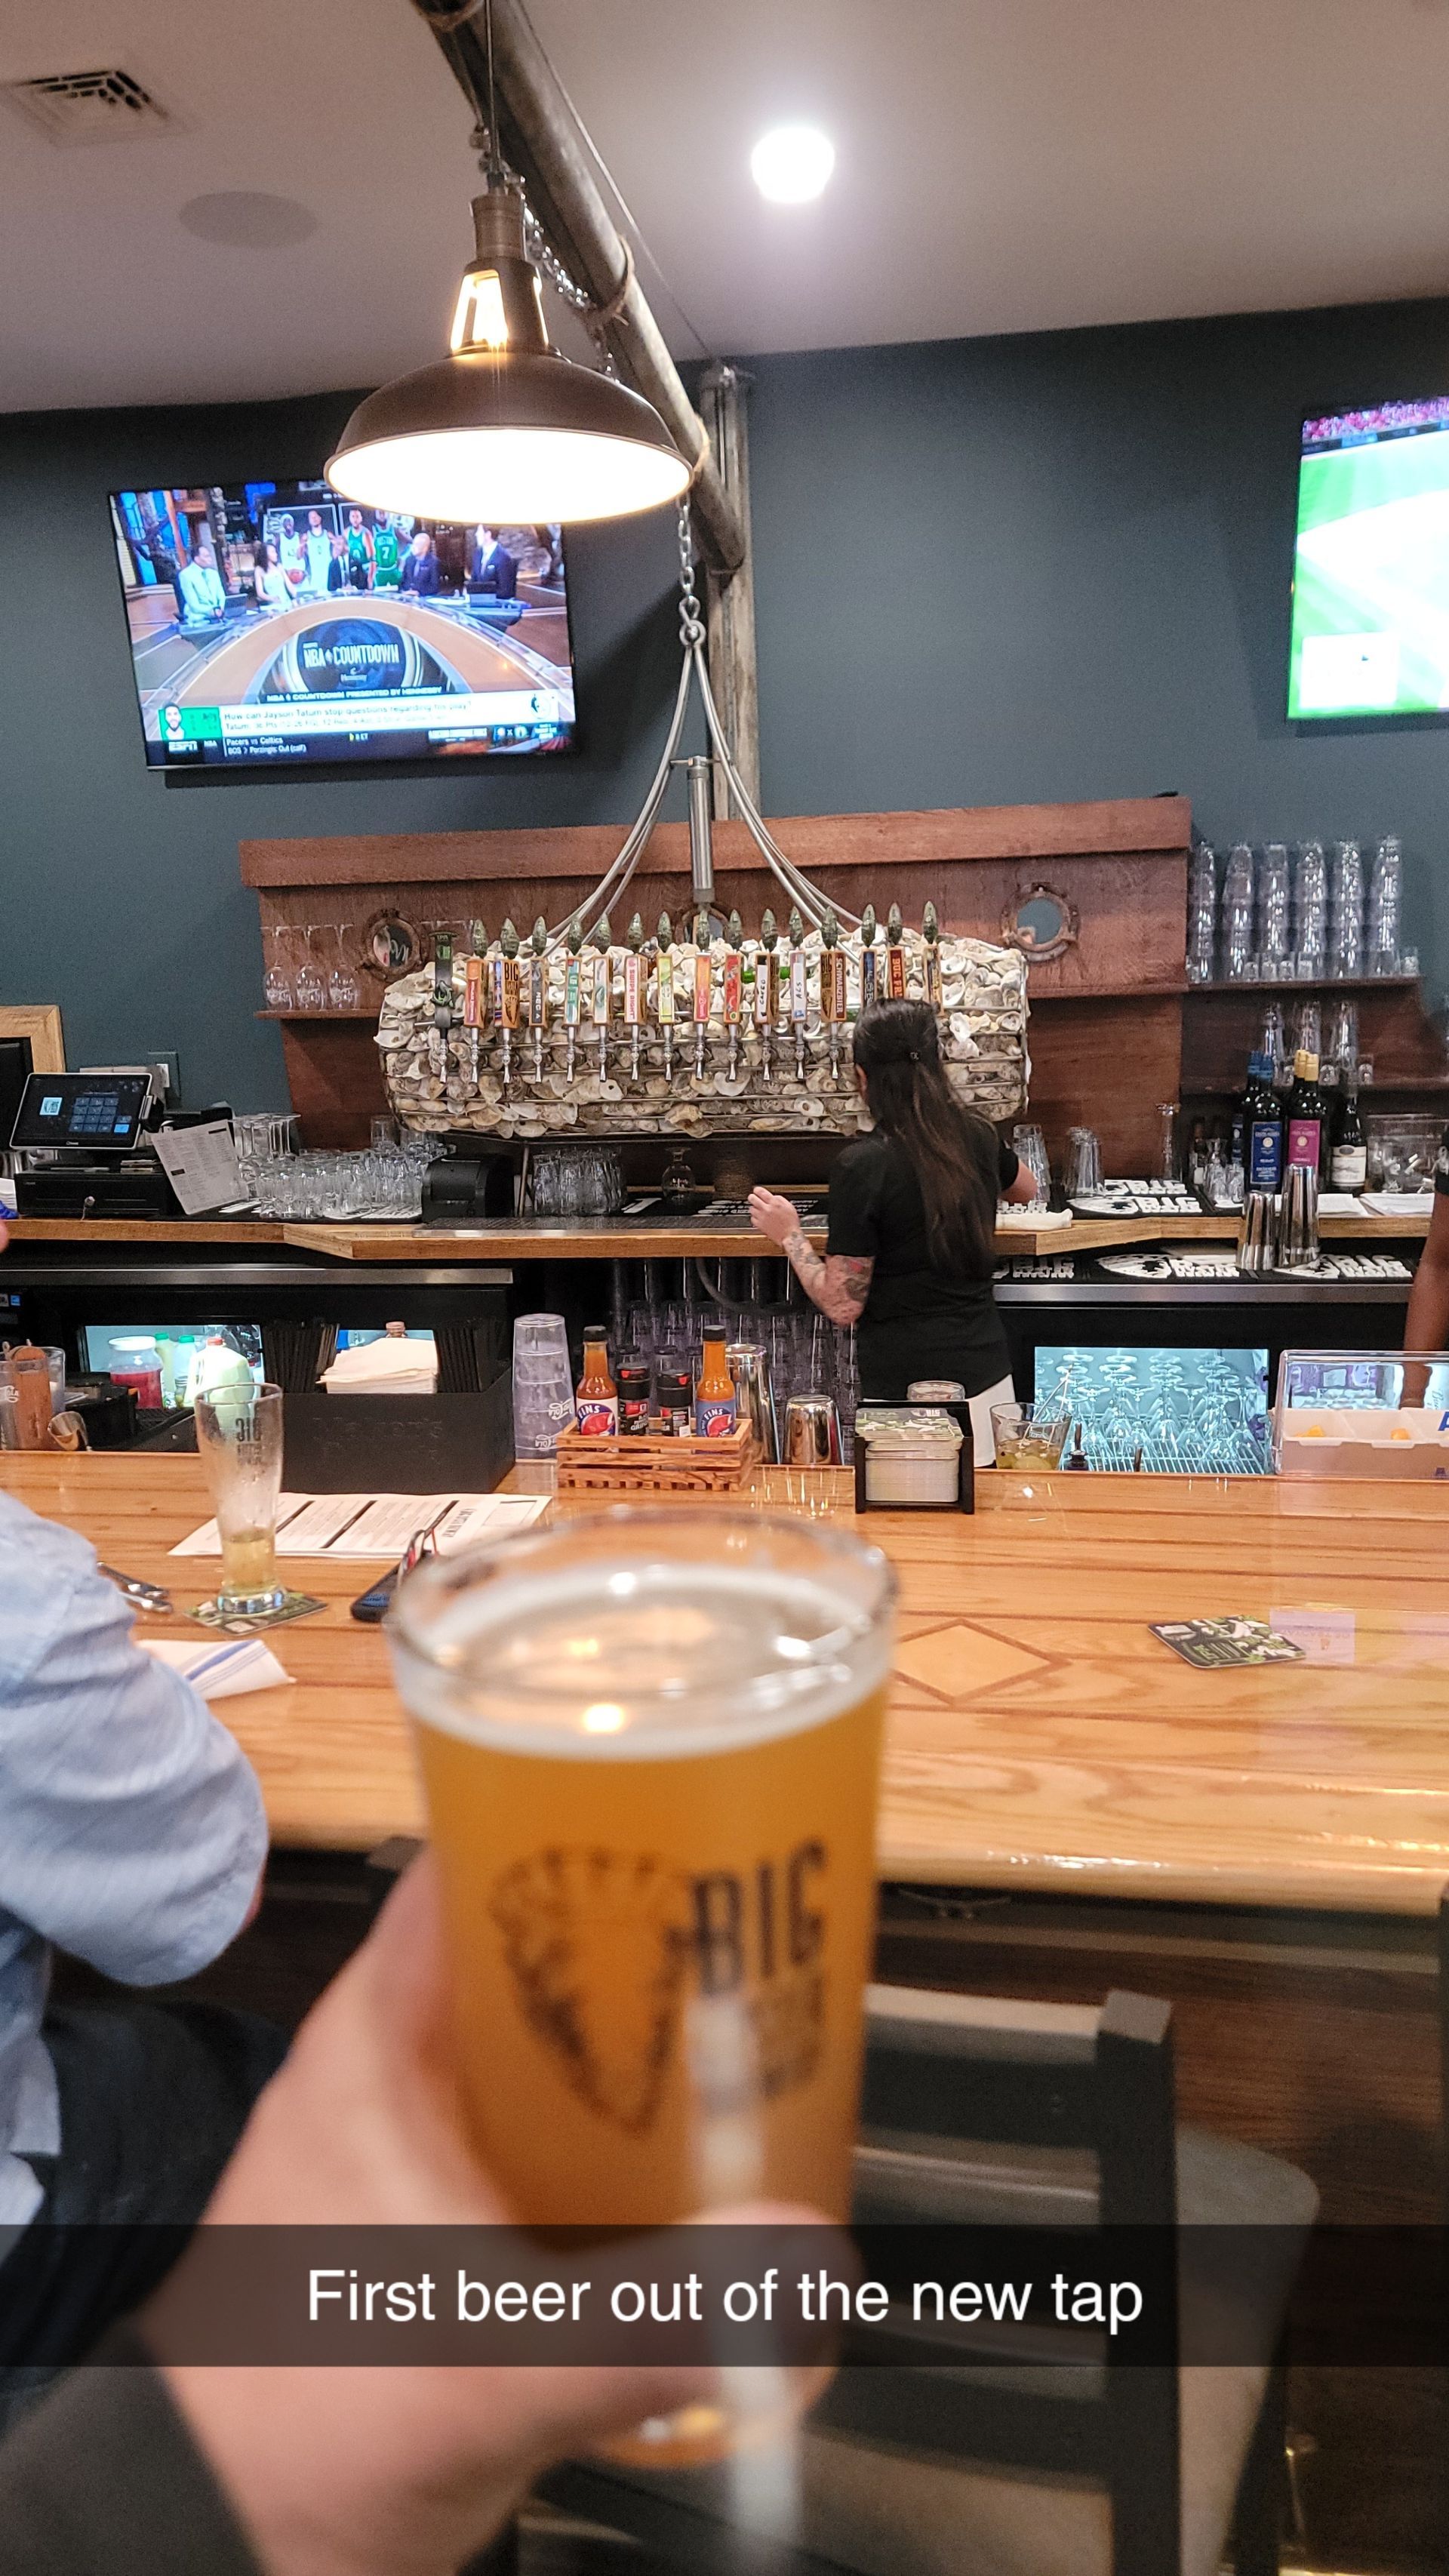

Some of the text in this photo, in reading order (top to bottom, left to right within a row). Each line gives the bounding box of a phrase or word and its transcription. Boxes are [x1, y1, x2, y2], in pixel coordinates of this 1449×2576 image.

[303, 644, 400, 668] NBA COUNTDOWN
[293, 691, 345, 701] COUNTDOWN
[346, 689, 389, 699] PRESENTED
[390, 688, 401, 696] BY
[402, 686, 442, 695] HENNESSY
[296, 708, 322, 718] Tatum
[168, 740, 198, 752] ESPN
[226, 738, 249, 746] Pacers
[260, 737, 284, 745] Celtics
[820, 953, 832, 974] BIG
[504, 962, 519, 982] BIG
[835, 957, 844, 1014] SCHWARZBIER
[1135, 1196, 1202, 1214] BIG
[577, 1405, 601, 1419] FINS
[703, 1408, 723, 1420] FINS
[691, 1834, 829, 2002] BIG
